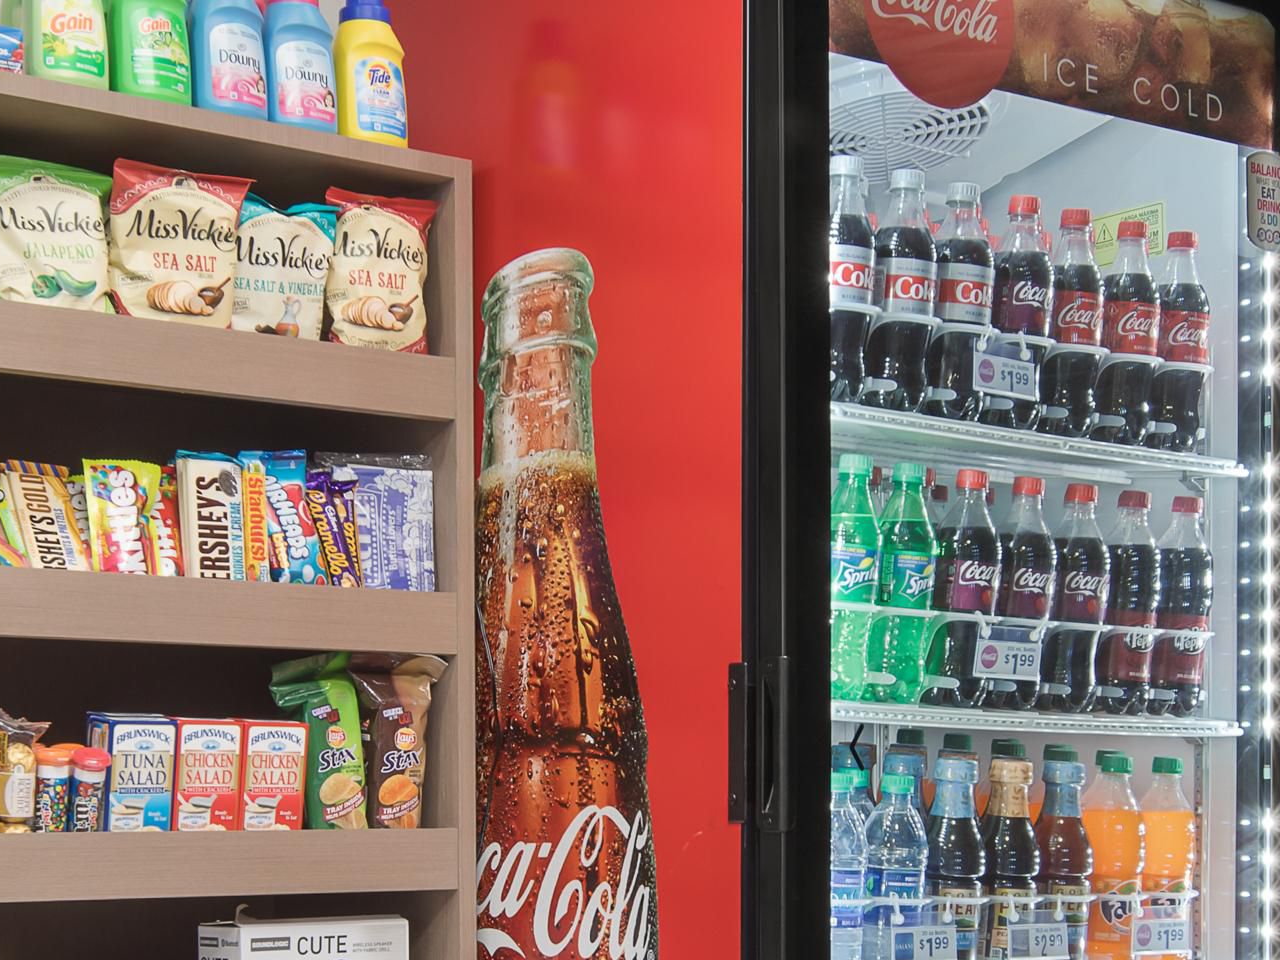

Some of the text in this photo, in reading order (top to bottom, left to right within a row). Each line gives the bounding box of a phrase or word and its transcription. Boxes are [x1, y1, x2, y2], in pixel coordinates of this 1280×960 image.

[50, 12, 94, 34] Gain
[368, 67, 391, 87] Tide
[1043, 52, 1223, 123] ICE COLD
[1261, 186, 1275, 200] EAT
[1257, 199, 1280, 214] DRINK
[1267, 214, 1278, 226] DO
[152, 251, 217, 274] SEA SALT
[122, 753, 165, 770] TUNA
[185, 752, 235, 769] CHICKEN
[251, 752, 299, 769] CHICKEN
[118, 770, 168, 786] SALAD
[185, 770, 233, 786] SALAD
[297, 935, 348, 956] CUTE
